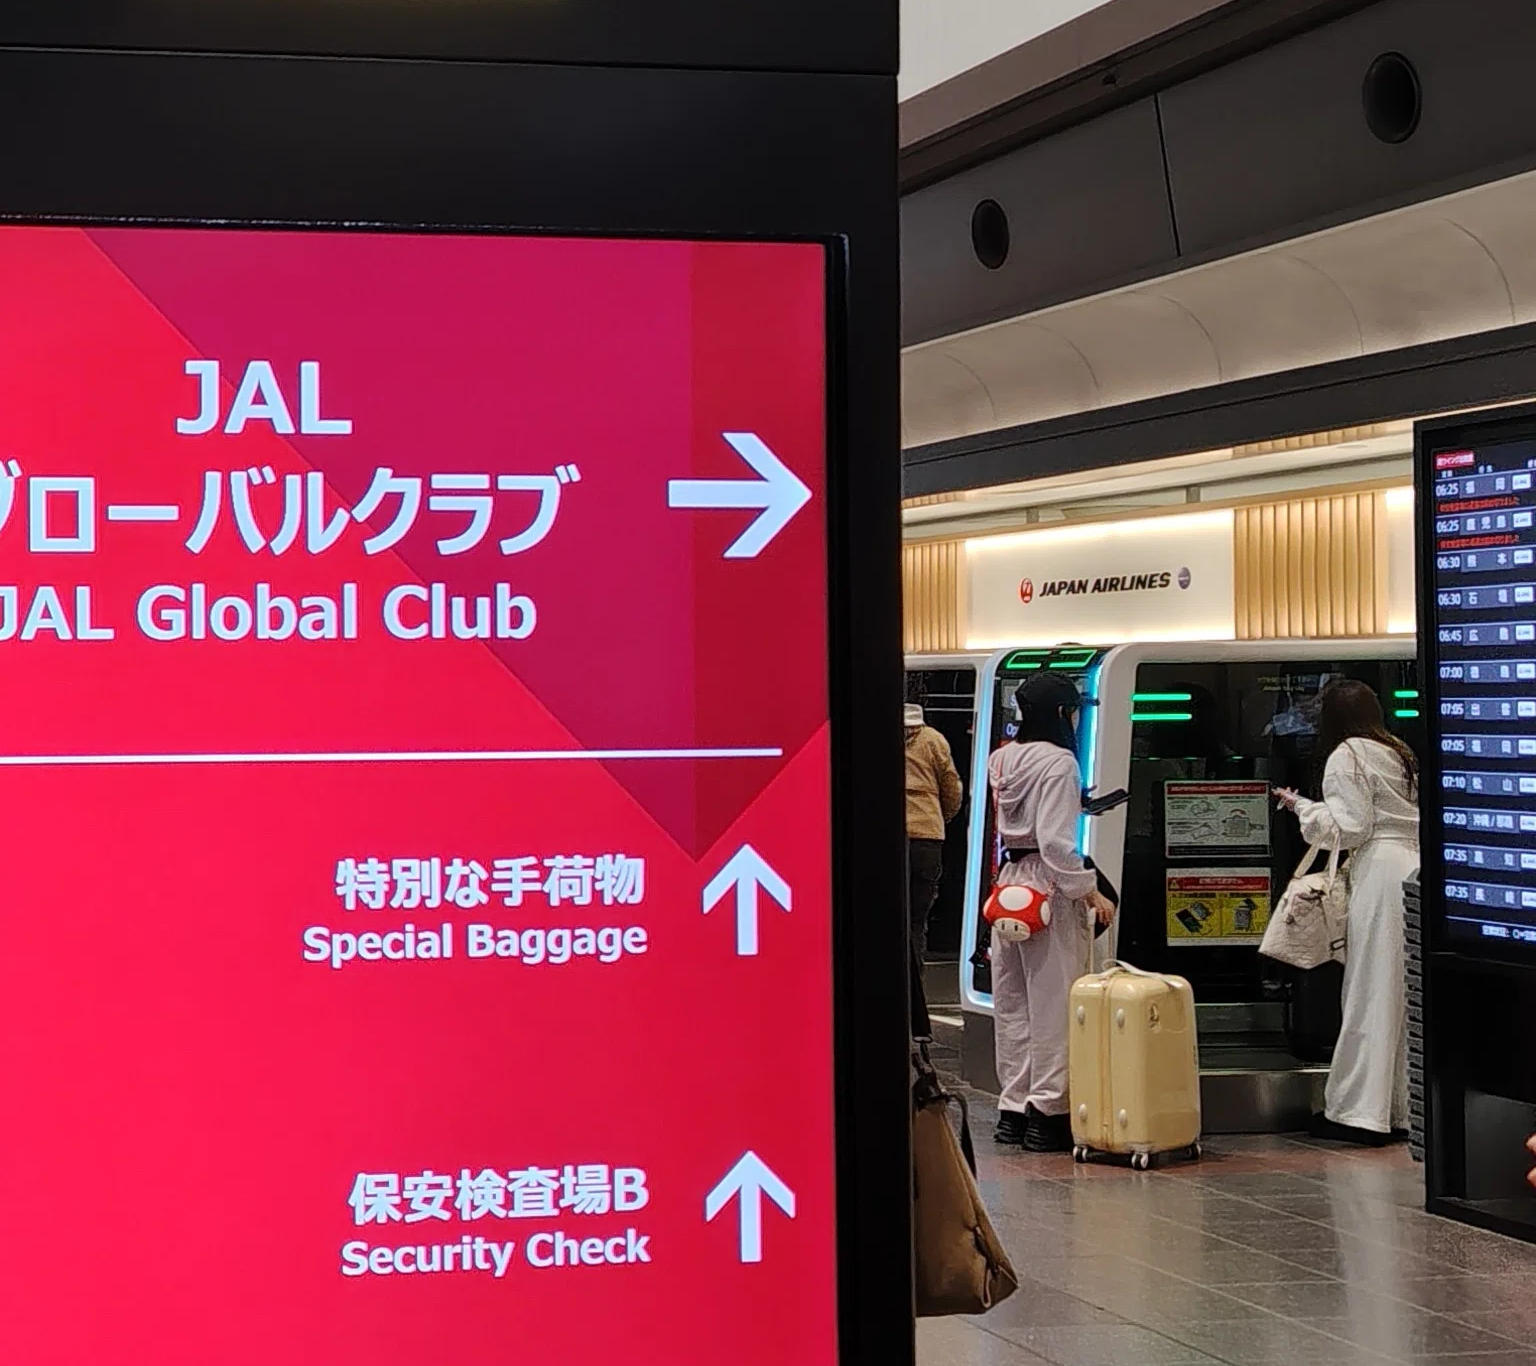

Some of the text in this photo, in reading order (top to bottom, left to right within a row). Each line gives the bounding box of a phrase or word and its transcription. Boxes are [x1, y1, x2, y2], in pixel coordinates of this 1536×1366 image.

[176, 360, 353, 435] JAL
[1437, 556, 1461, 569] 06:30
[1039, 572, 1172, 597] JAPAN AIRLINES
[136, 582, 357, 641] Global
[383, 582, 537, 641] Club
[1438, 593, 1461, 606] 06:30
[1439, 629, 1462, 642] 06:45
[1440, 666, 1463, 679] 07:00
[1441, 703, 1464, 715] 07:05
[1442, 776, 1466, 789] 07:10
[335, 853, 645, 911] 特別な手荷物
[303, 922, 648, 969] Special Baggage
[347, 1164, 650, 1227] 保安検査場B
[341, 1228, 651, 1278] Security Check
